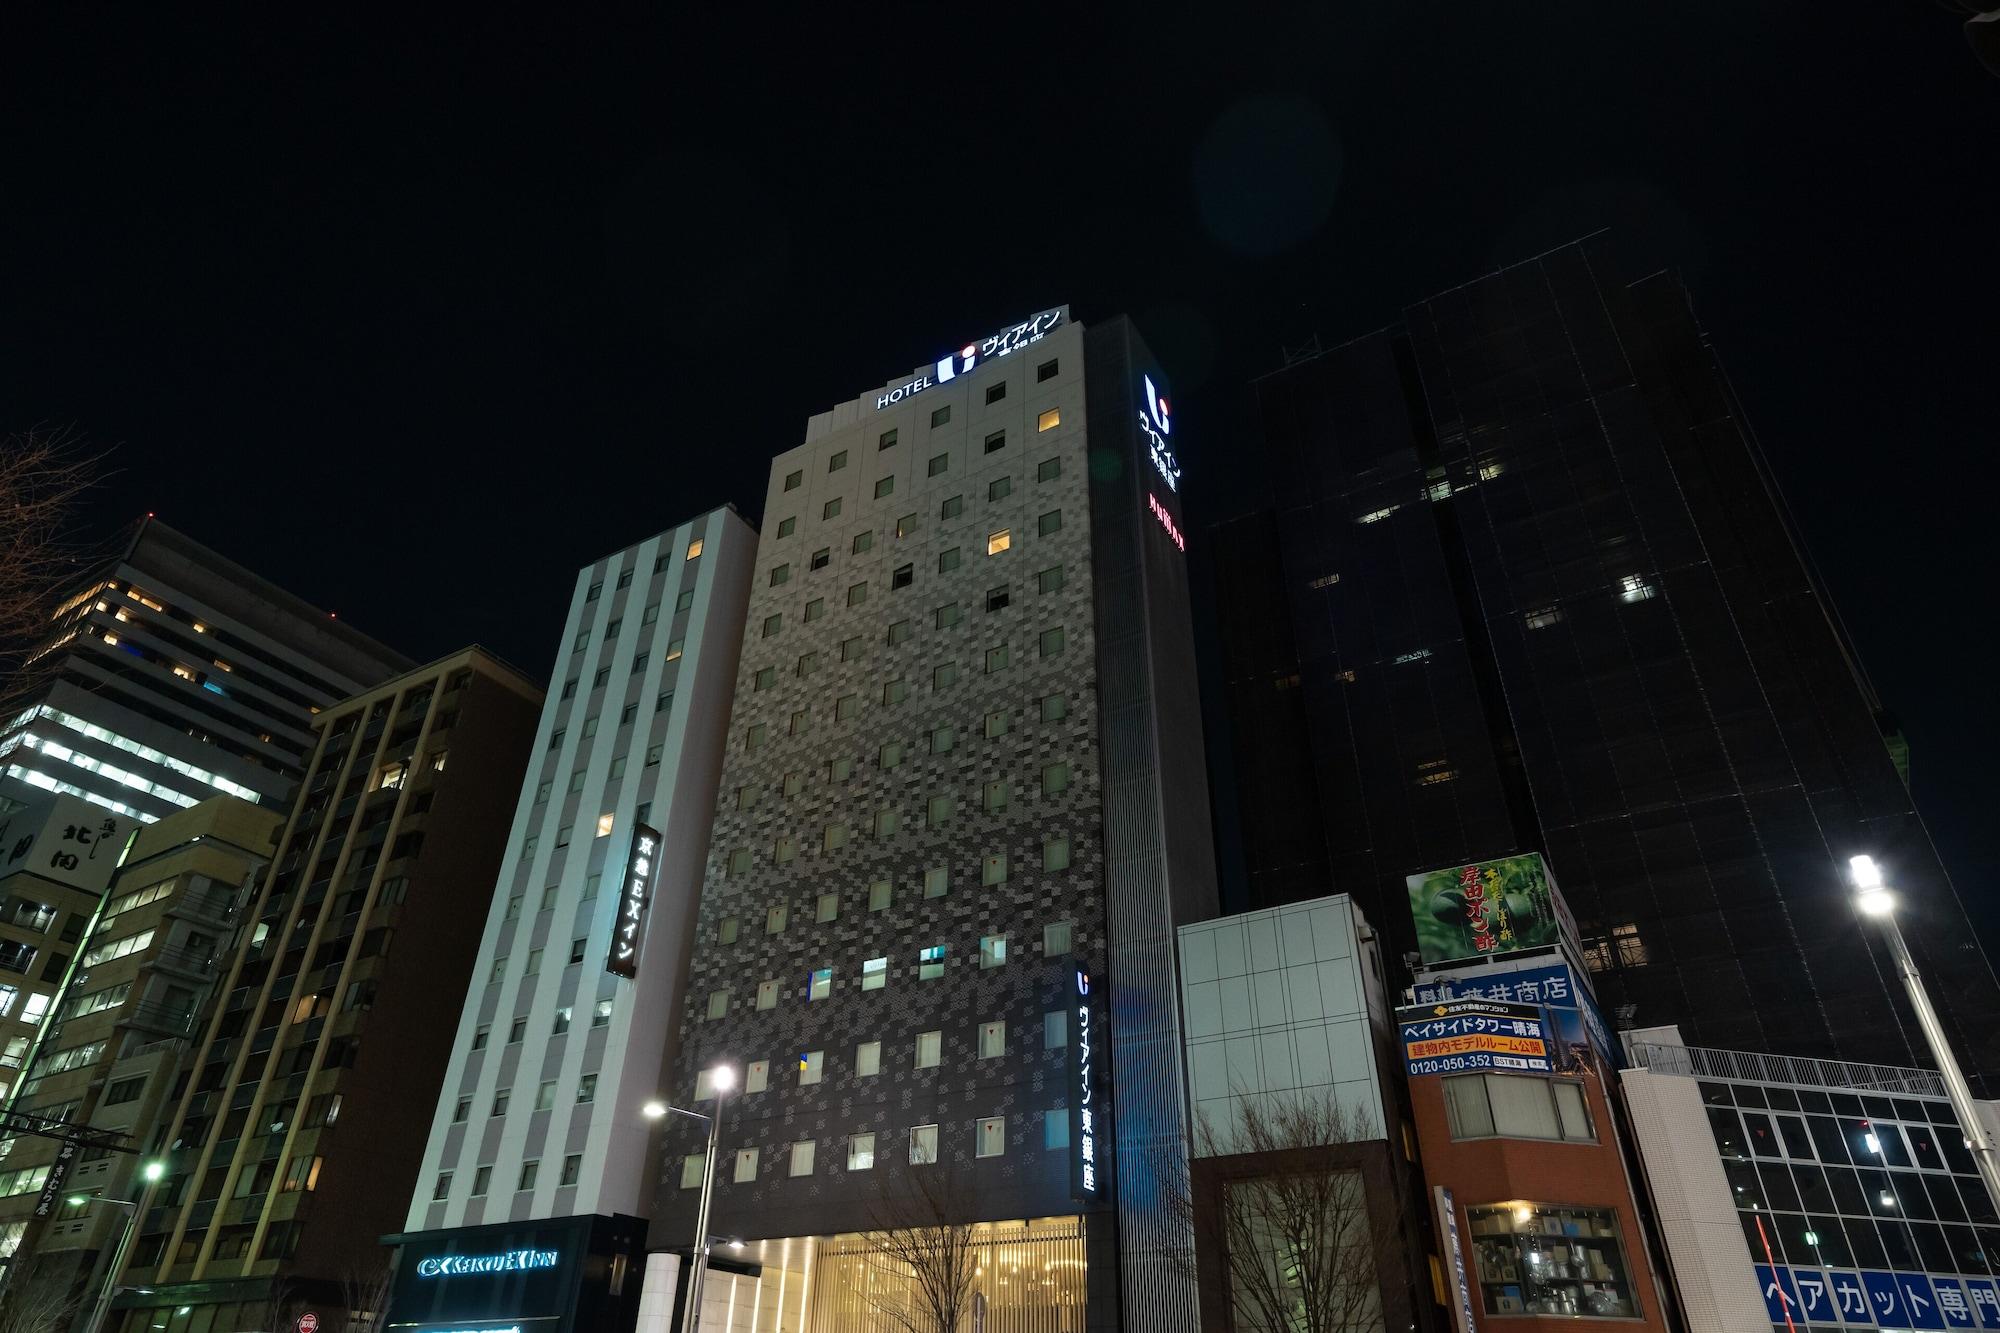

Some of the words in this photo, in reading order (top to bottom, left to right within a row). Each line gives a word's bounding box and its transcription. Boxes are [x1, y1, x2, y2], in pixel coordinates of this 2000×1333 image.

[877, 376, 932, 410] HOTEL
[982, 310, 1060, 356] ヴィアイン
[1460, 866, 1499, 952] 岸田ポン酢
[1405, 1015, 1541, 1037] ベイサイドタワー晴海
[1413, 1037, 1542, 1056] 建物内モデルルーム公開
[1411, 1054, 1491, 1074] 0120-050-352
[1767, 1279, 2000, 1323] ヘアカット専門
